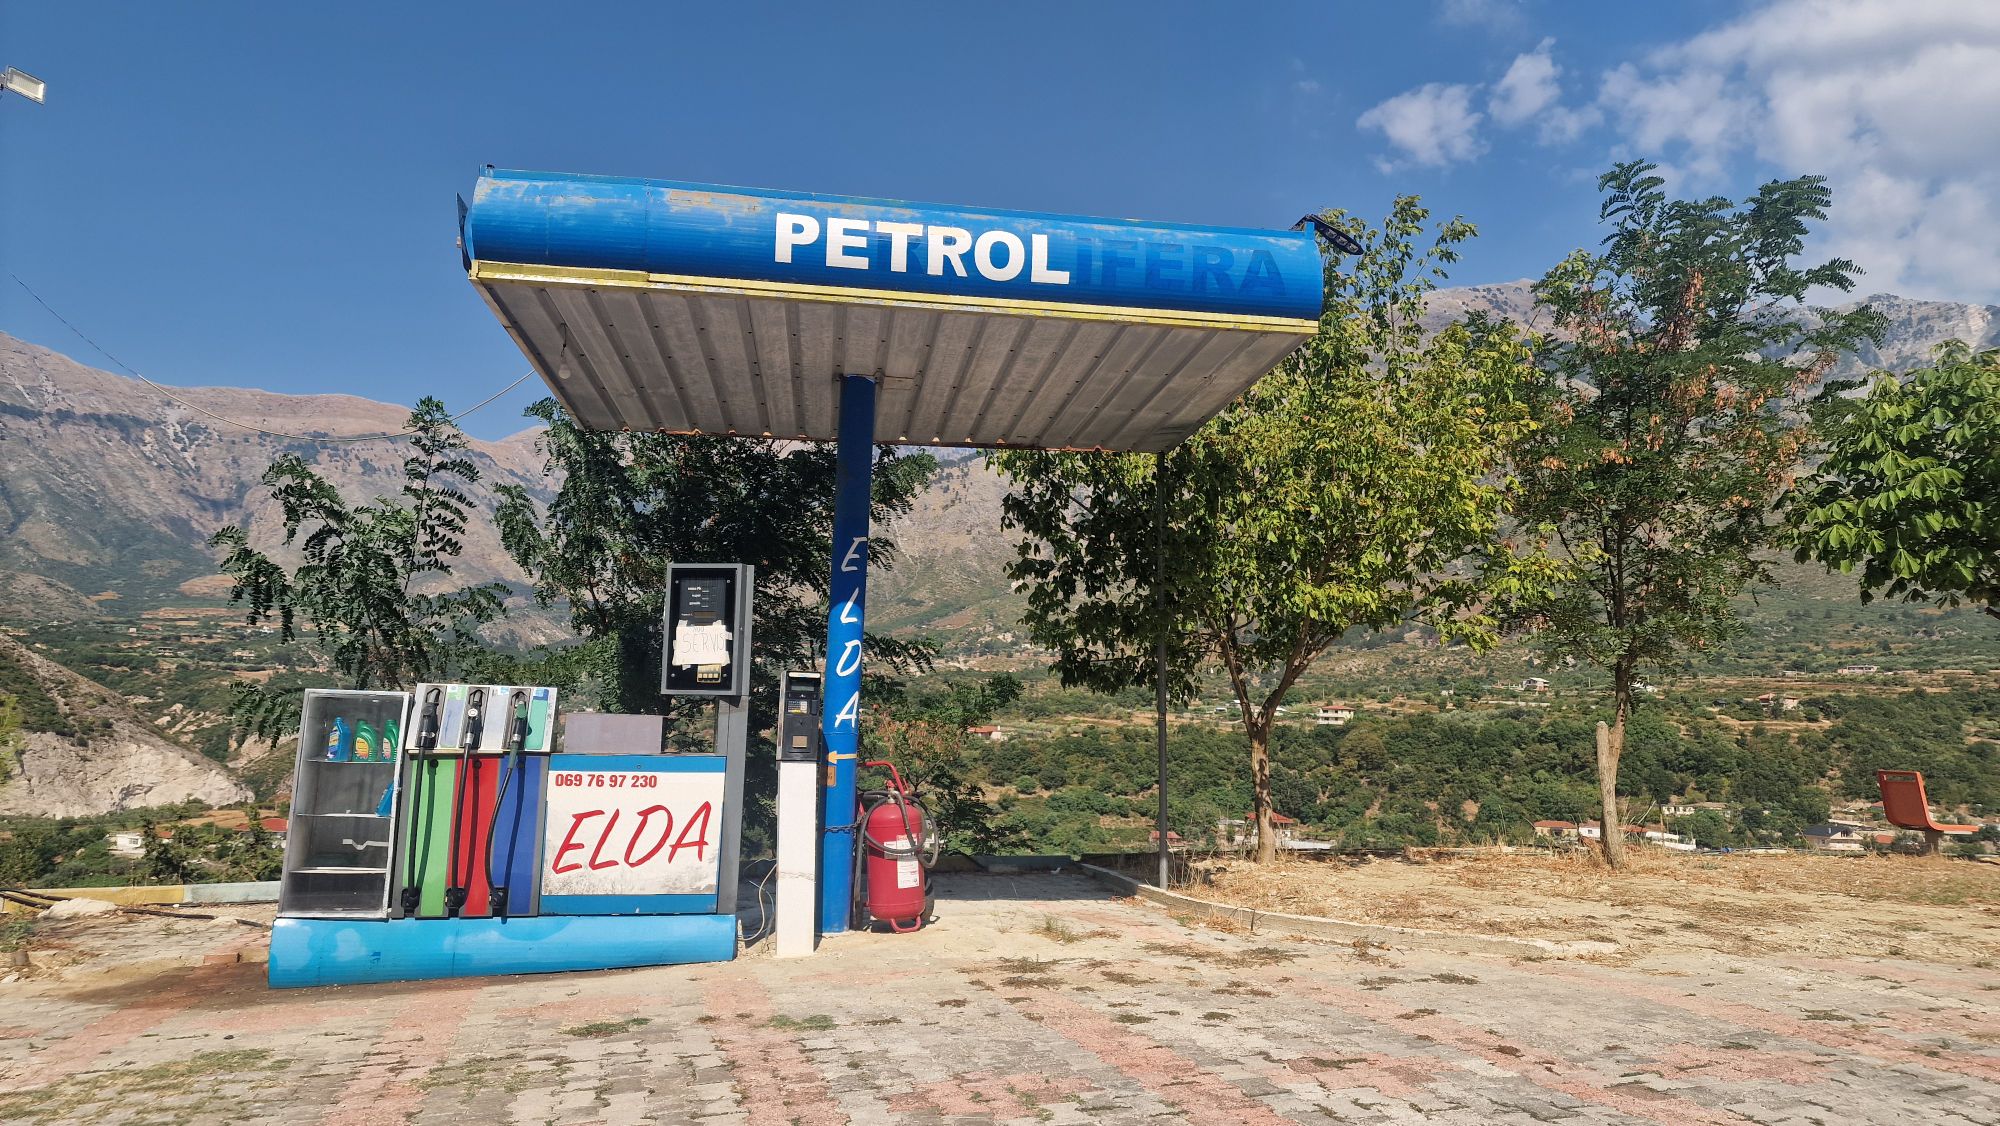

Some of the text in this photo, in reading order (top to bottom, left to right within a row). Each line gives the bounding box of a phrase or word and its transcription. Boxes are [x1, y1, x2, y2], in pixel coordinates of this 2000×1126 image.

[774, 212, 1070, 285] PETROL
[834, 536, 868, 729] ELDA
[555, 773, 658, 788] 069 76 97 230
[551, 800, 712, 875] ELDA
